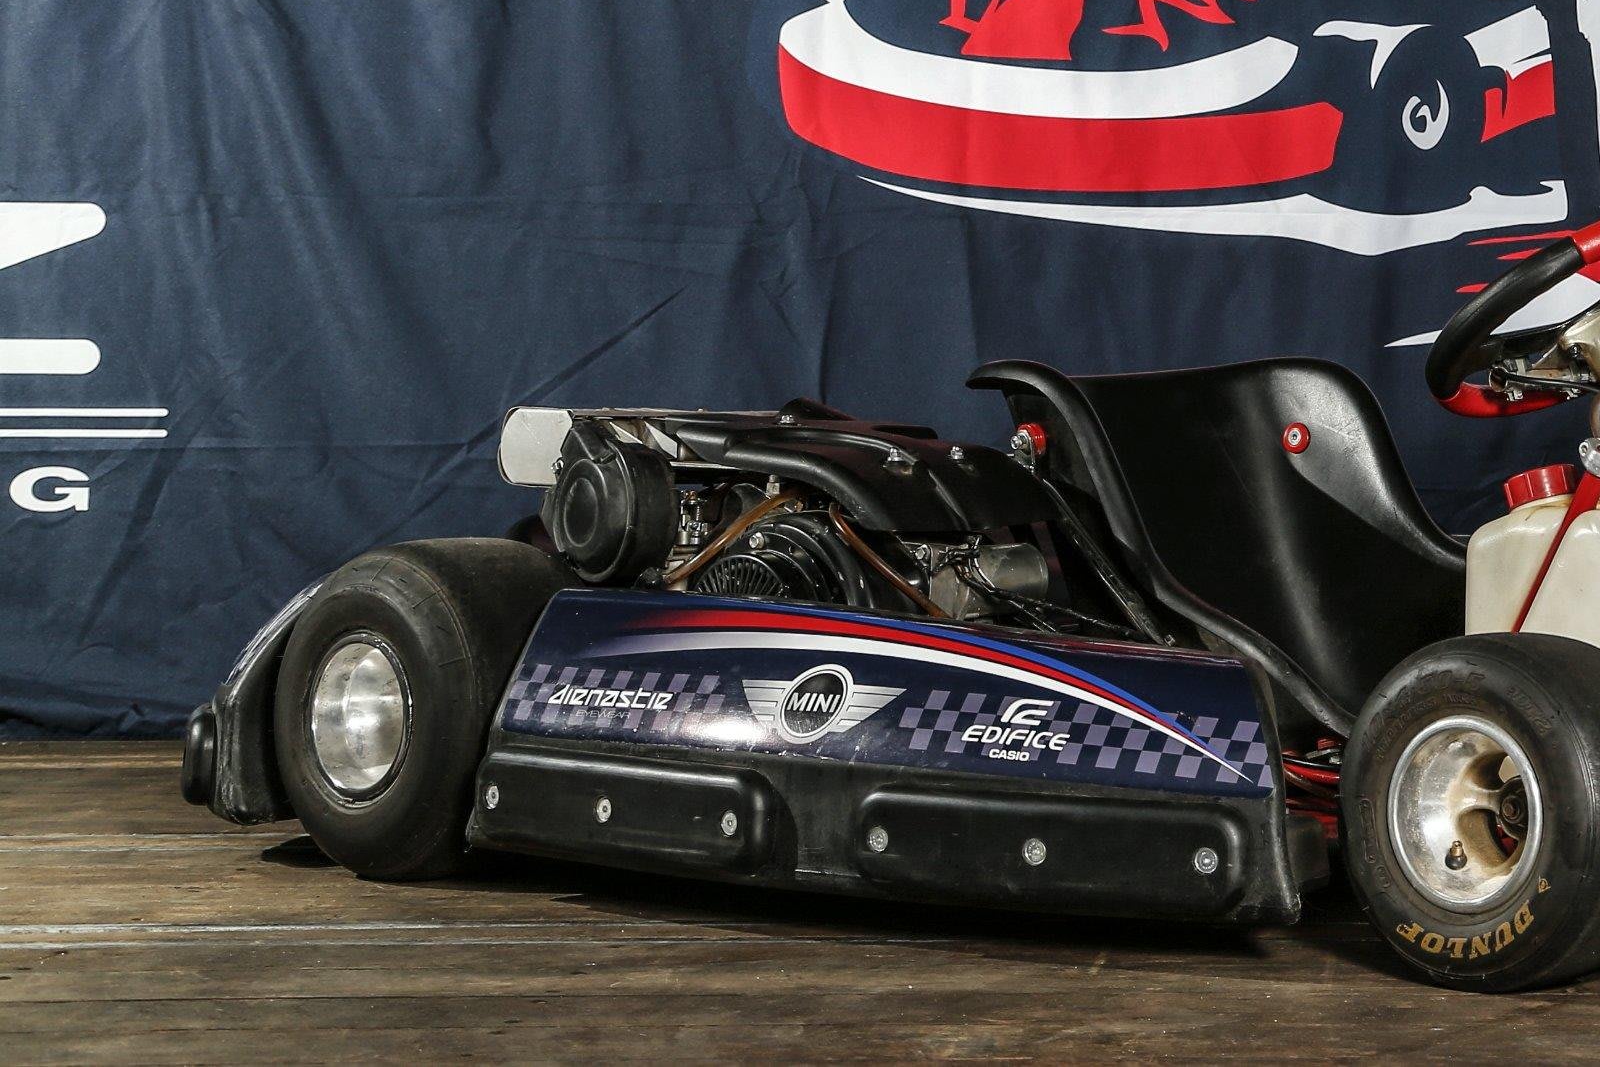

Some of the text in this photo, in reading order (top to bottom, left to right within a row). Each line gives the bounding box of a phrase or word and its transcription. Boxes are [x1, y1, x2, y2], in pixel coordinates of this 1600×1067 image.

[788, 691, 841, 713] MINI
[575, 709, 631, 719] EYEWEAR
[961, 724, 1071, 751] EDIFICE
[989, 748, 1029, 762] CASIO
[1396, 900, 1535, 959] DUNLOP
